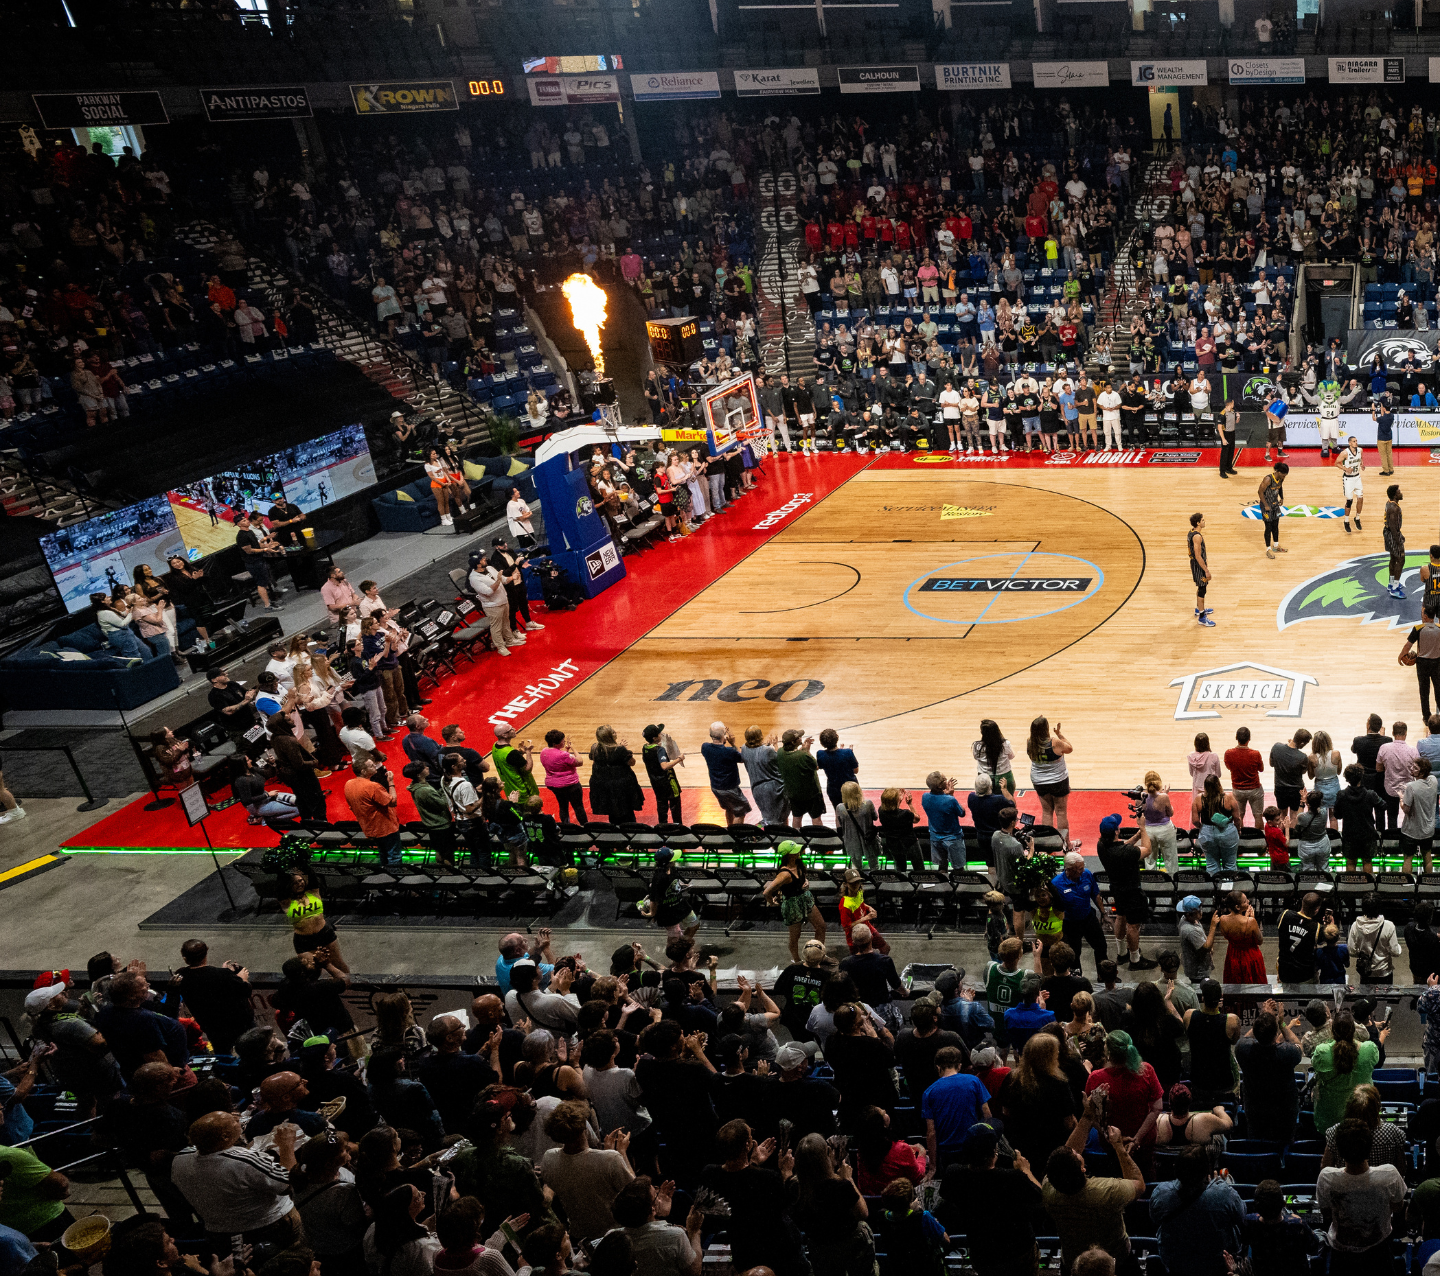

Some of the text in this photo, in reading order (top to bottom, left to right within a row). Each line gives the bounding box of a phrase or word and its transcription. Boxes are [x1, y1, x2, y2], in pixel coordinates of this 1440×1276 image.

[752, 74, 782, 83] Karat
[943, 66, 1002, 77] BURTNIK
[660, 77, 703, 87] Reliance
[945, 75, 1003, 84] PRINTING INC.
[468, 80, 504, 95] 00.0
[76, 95, 121, 105] PARKWAY
[208, 95, 307, 110] ANTIPASTOS
[357, 86, 450, 111] KROWN
[81, 105, 128, 120] SOCIAL
[681, 322, 696, 338] 00.0
[675, 430, 709, 440] Marke
[1083, 451, 1147, 464] MOBILE
[932, 580, 1081, 590] BETVICTOR
[651, 679, 826, 703] neo
[1202, 683, 1284, 699] SKRTICH
[487, 695, 540, 725] THE
[292, 901, 321, 918] NRL
[1288, 925, 1310, 937] LOWRY
[1289, 935, 1302, 953] 7
